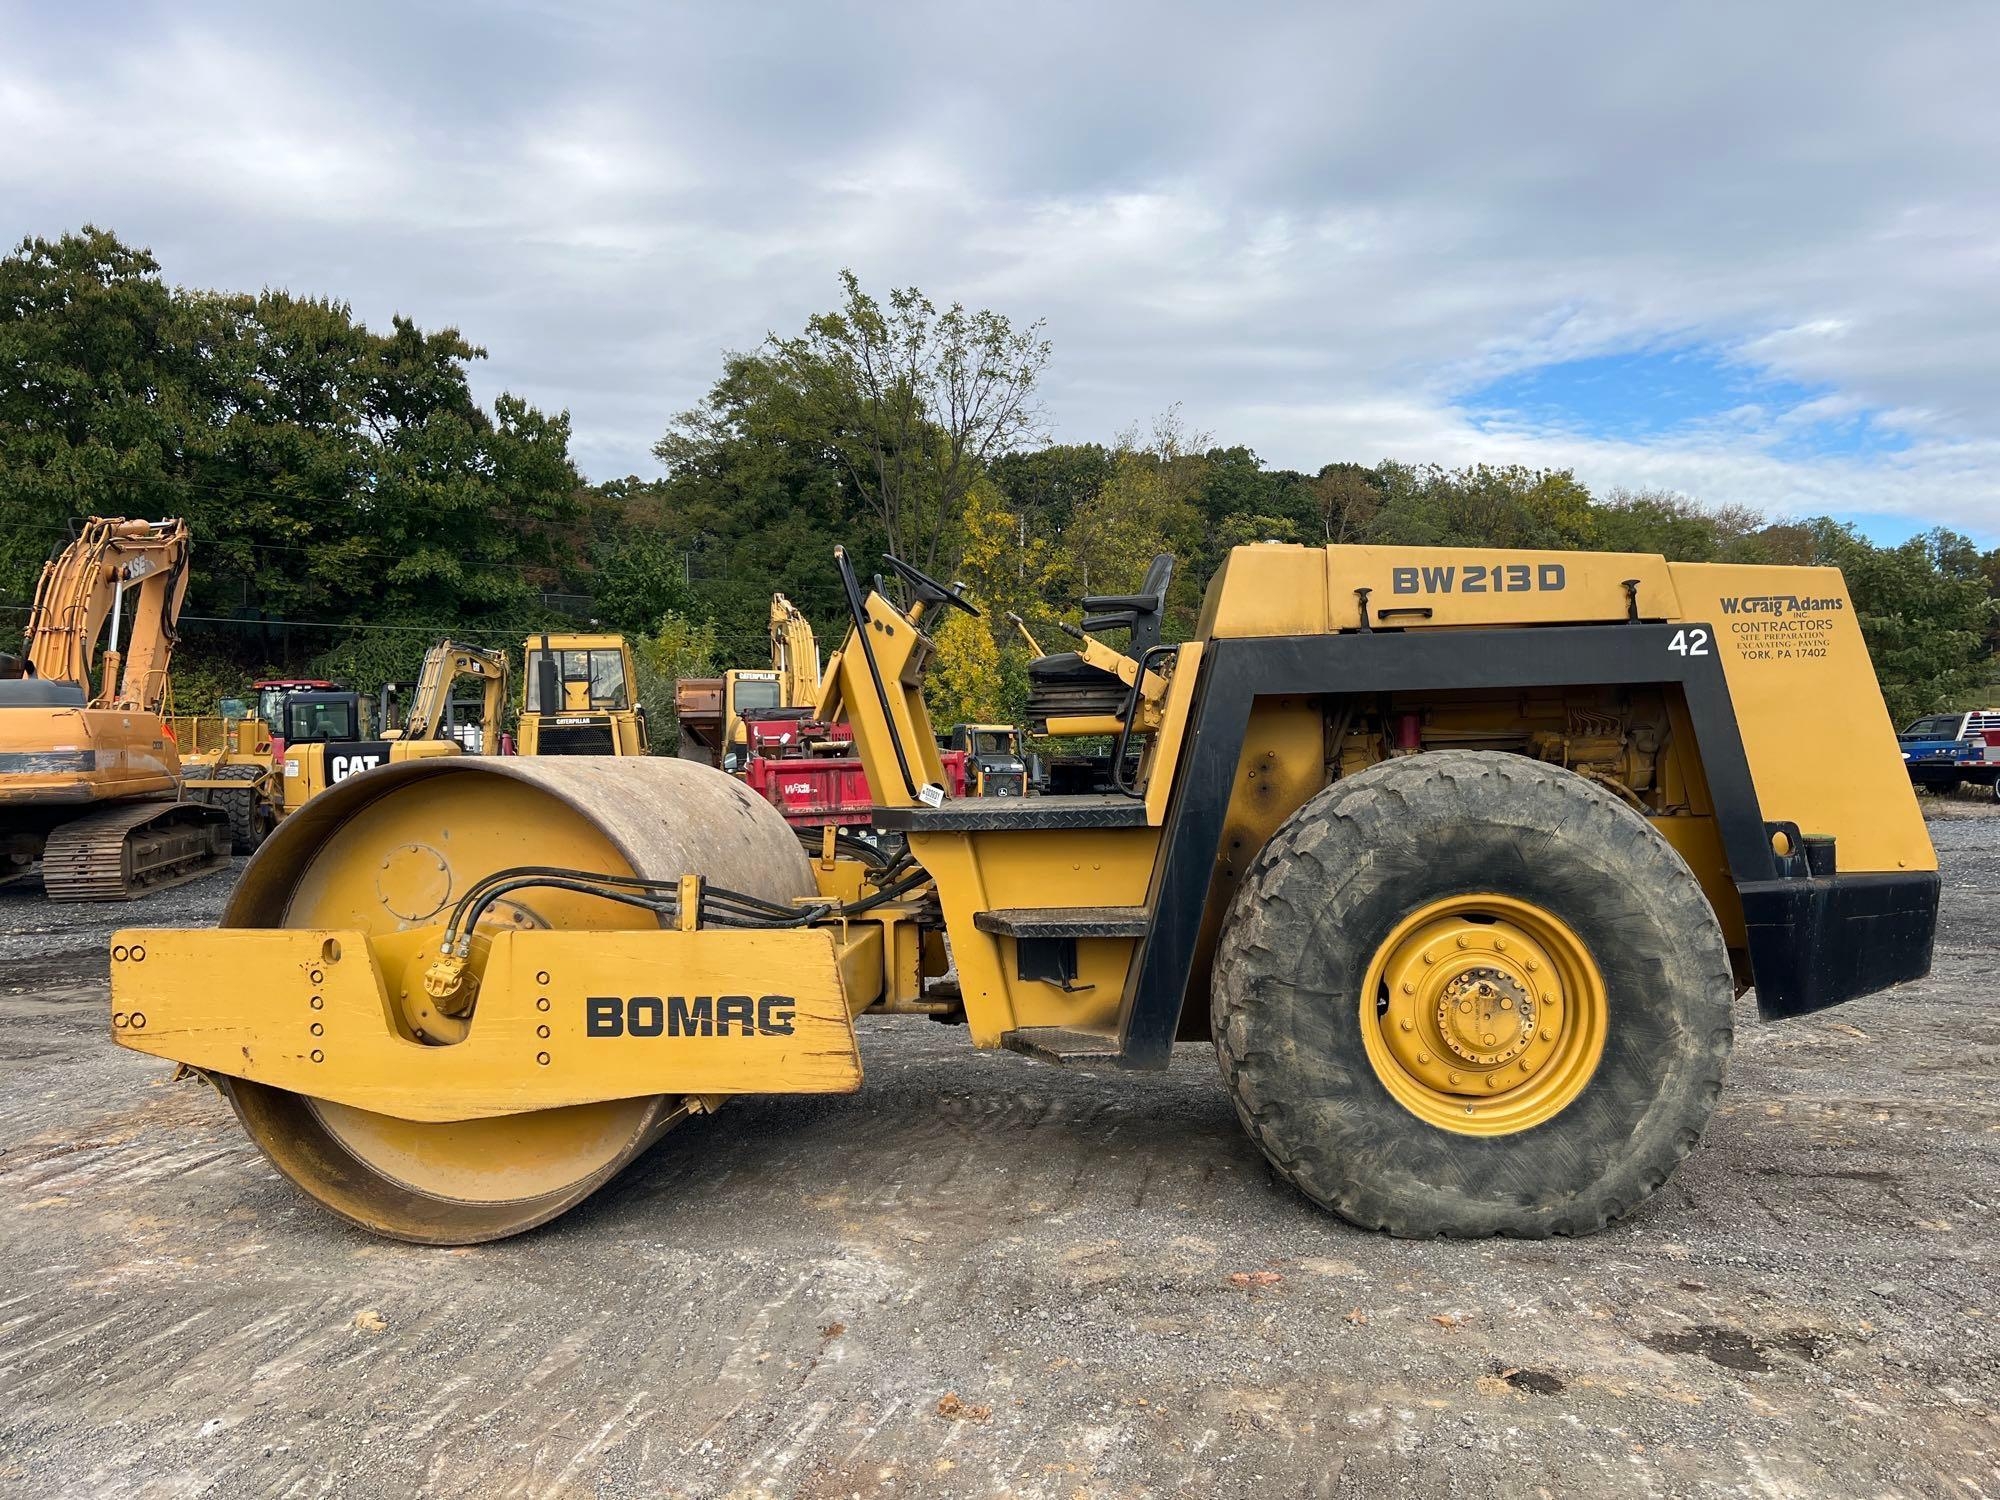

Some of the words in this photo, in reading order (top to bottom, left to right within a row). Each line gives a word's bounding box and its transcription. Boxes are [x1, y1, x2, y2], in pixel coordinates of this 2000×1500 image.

[1786, 596, 1843, 612] Adams
[1731, 619, 1833, 633] CONTRACTORS
[1667, 629, 1709, 657] 42
[1764, 631, 1825, 640] PREPARATION
[1736, 641, 1791, 650] EXCAVATING
[1798, 639, 1830, 647] PAVING
[1741, 650, 1774, 660] YORK,
[1777, 650, 1792, 658] PA
[1796, 648, 1827, 658] 17402
[332, 755, 380, 783] CAT
[586, 995, 796, 1038] BOMAG
